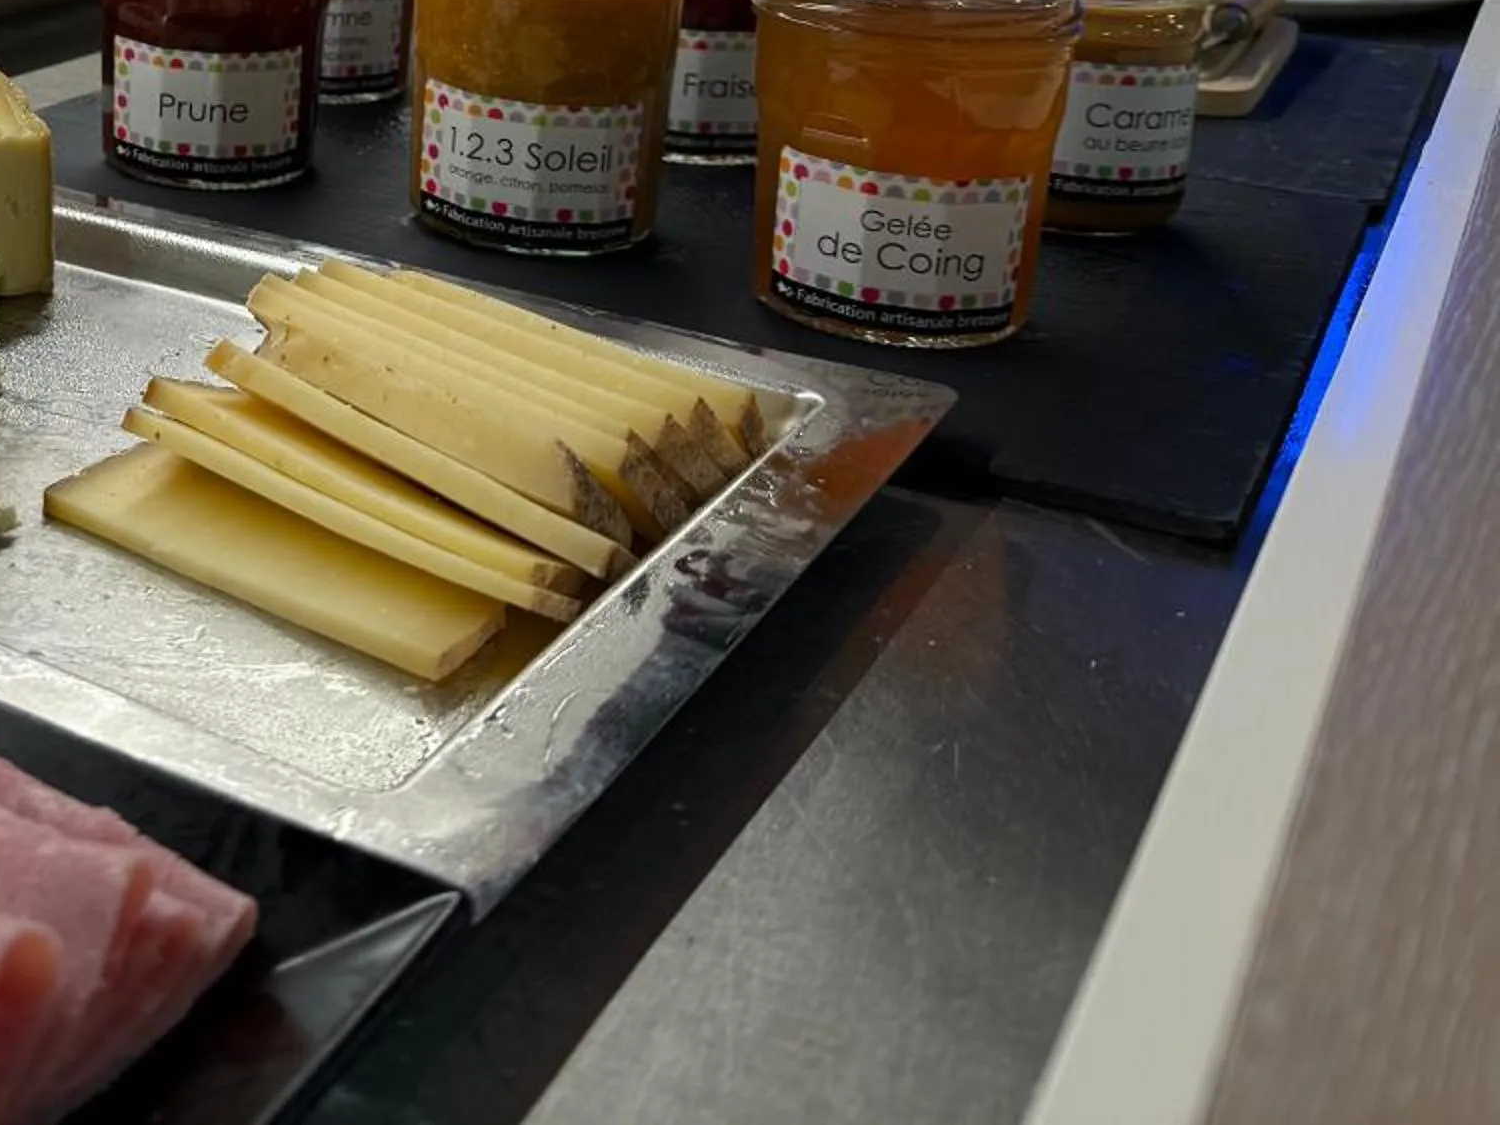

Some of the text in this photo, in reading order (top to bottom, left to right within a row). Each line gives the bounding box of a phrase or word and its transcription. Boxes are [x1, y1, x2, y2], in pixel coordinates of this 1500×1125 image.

[158, 92, 249, 124] Prune
[450, 125, 612, 174] 1.2.3 Soleil
[1083, 135, 1111, 151] au
[442, 204, 504, 233] Fabrication
[508, 223, 573, 241] artisanale
[860, 208, 953, 241] Gelée
[817, 231, 985, 283] de Coing
[796, 287, 876, 321] Fabrication
[880, 311, 954, 328] artisanale
